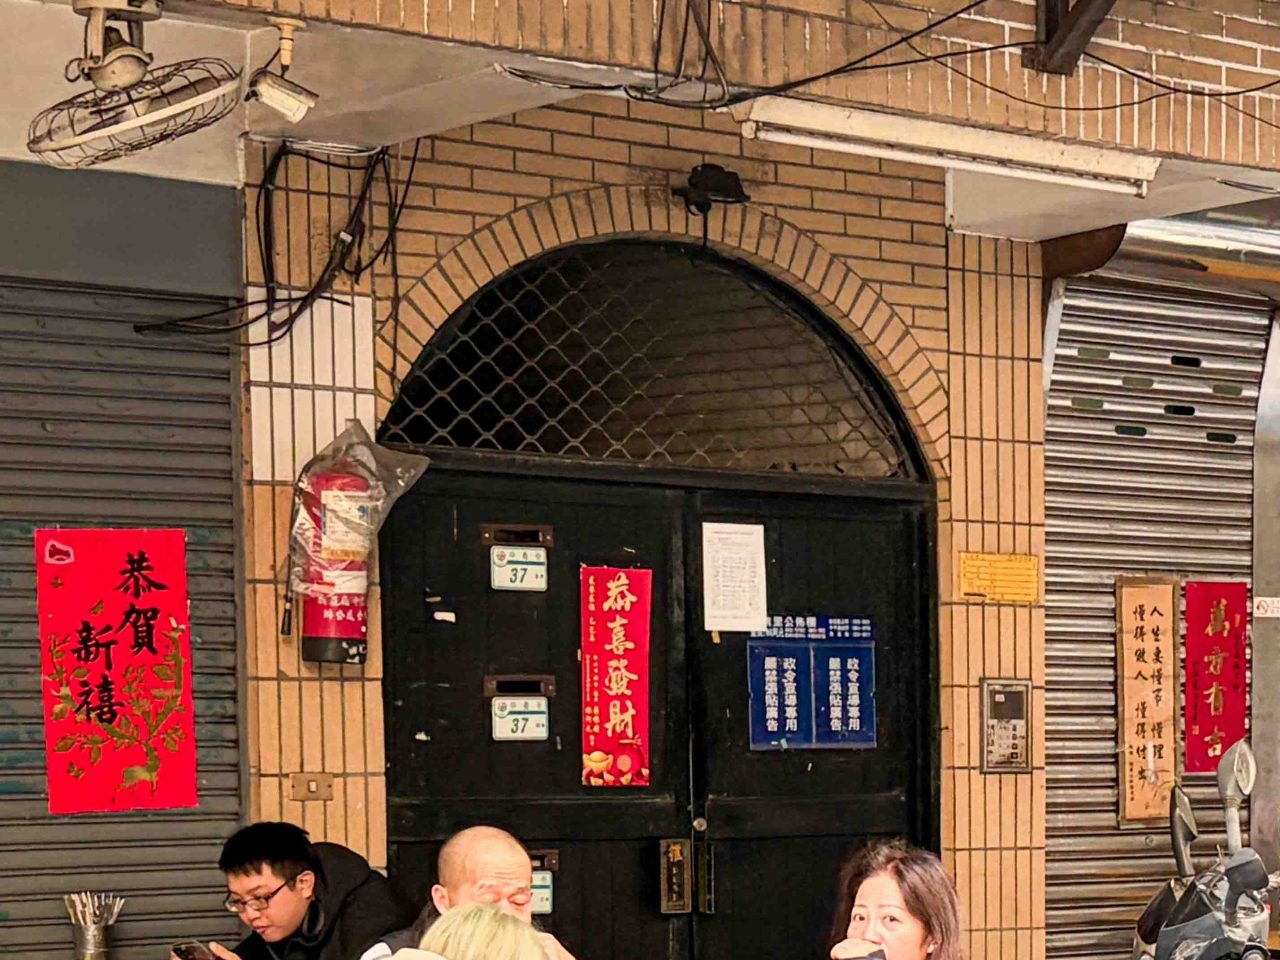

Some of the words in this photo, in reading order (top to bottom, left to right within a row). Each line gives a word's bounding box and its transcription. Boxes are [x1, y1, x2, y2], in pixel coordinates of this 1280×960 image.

[114, 550, 168, 656] 恭賀
[509, 567, 528, 583] 37
[71, 620, 125, 725] 新禧
[602, 571, 638, 738] 恭喜發財
[510, 717, 529, 733] 37
[764, 656, 778, 731] 嚴禁張貼廣告
[783, 657, 798, 731] 政令宣導專用
[829, 657, 842, 731] 嚴禁張貼廣告
[847, 657, 860, 731] 政令宣導專用
